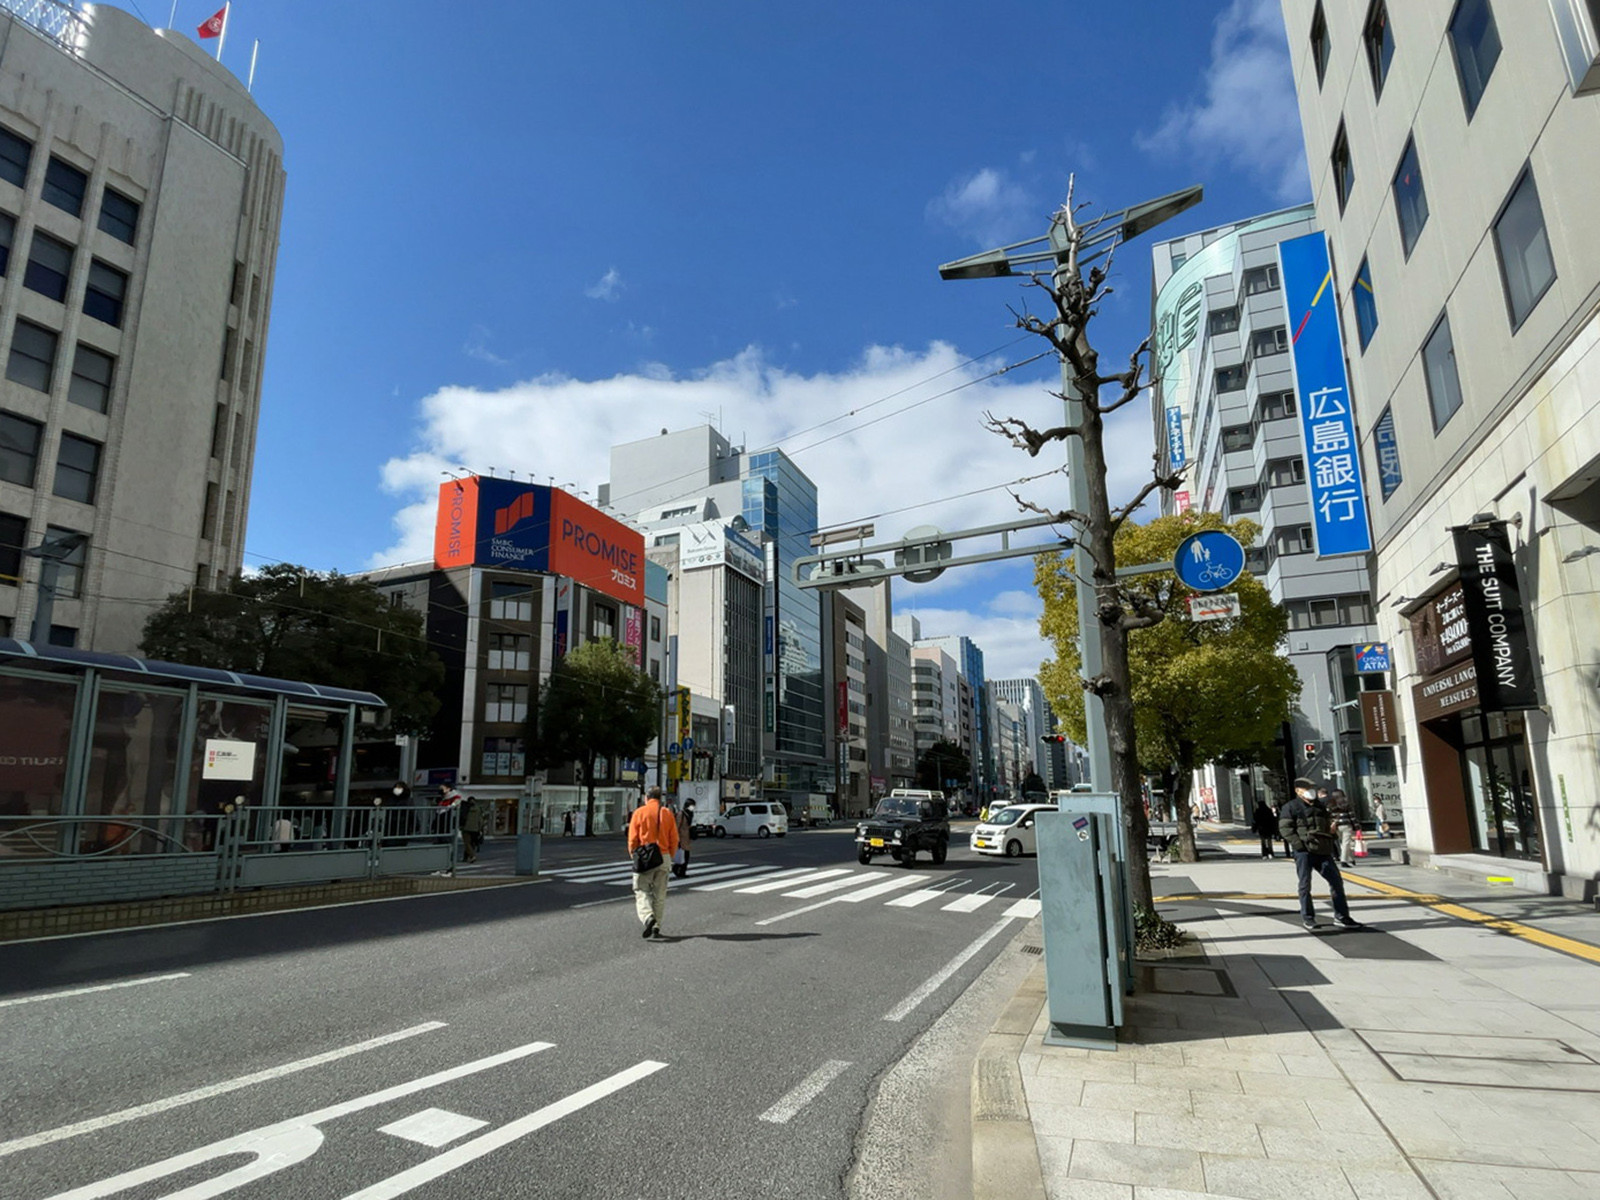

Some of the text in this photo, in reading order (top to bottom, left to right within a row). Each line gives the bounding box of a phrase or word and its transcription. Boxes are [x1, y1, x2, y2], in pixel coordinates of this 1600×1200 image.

[1307, 386, 1360, 523] 広島銀行
[449, 486, 464, 558] PROMISE
[491, 537, 514, 547] SMBC
[491, 545, 534, 557] CONSUMER
[562, 518, 638, 575] PROMISE
[610, 567, 637, 591] プロミス
[1475, 543, 1517, 689] THE SUIT COMPANY
[1363, 661, 1388, 671] ATM
[1423, 673, 1455, 697] UNIVERSAL
[1439, 685, 1477, 708] MEASURE'S
